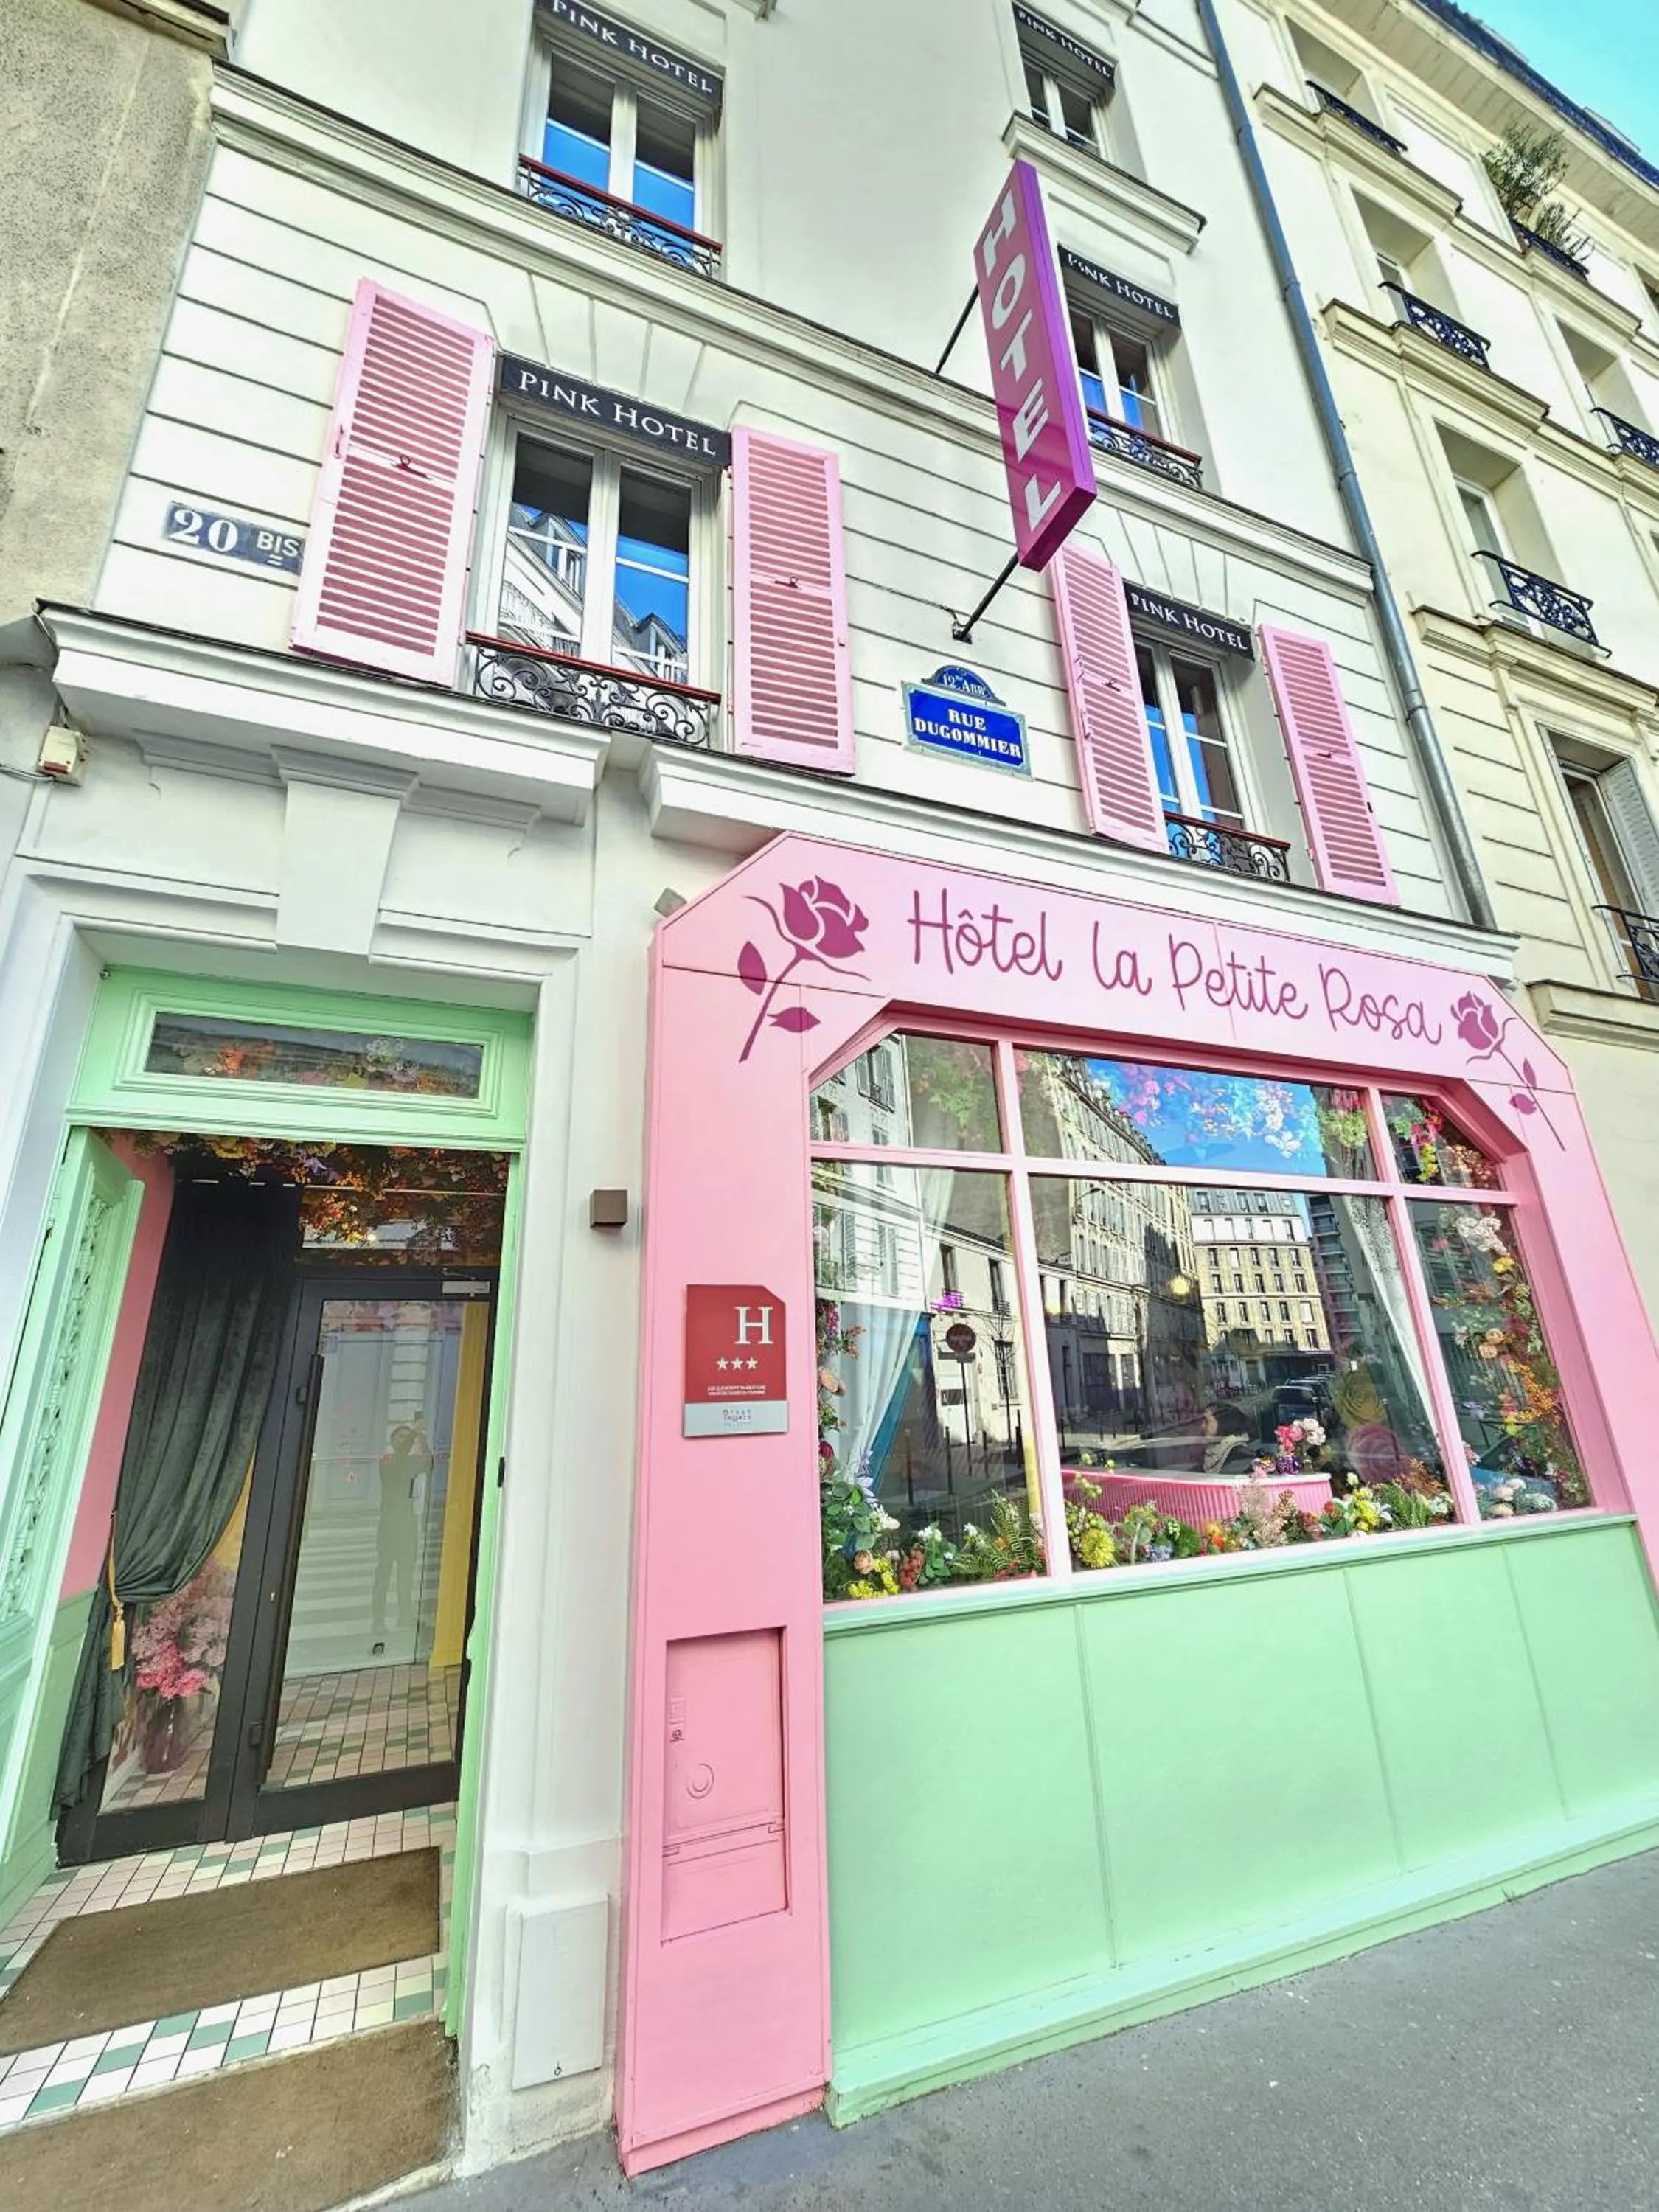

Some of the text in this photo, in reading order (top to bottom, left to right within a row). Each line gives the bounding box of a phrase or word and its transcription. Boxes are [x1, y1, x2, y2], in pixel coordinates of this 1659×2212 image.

[553, 0, 713, 93] PINK HOTEL
[1018, 10, 1110, 77] PINK HOTEL
[1068, 254, 1174, 319] PINK HOTEL
[983, 188, 1062, 532] HOTEL
[518, 370, 717, 456] PINK HOTEL
[169, 509, 300, 557] 20 BIS
[1130, 592, 1248, 650] PINK HOTEL
[914, 717, 1021, 759] DUGOMMIER
[947, 708, 987, 731] RUE
[908, 888, 1062, 981] Hôtel
[1169, 933, 1309, 1020] Petite
[1318, 963, 1441, 1045] Rosa
[734, 1306, 774, 1344] H
